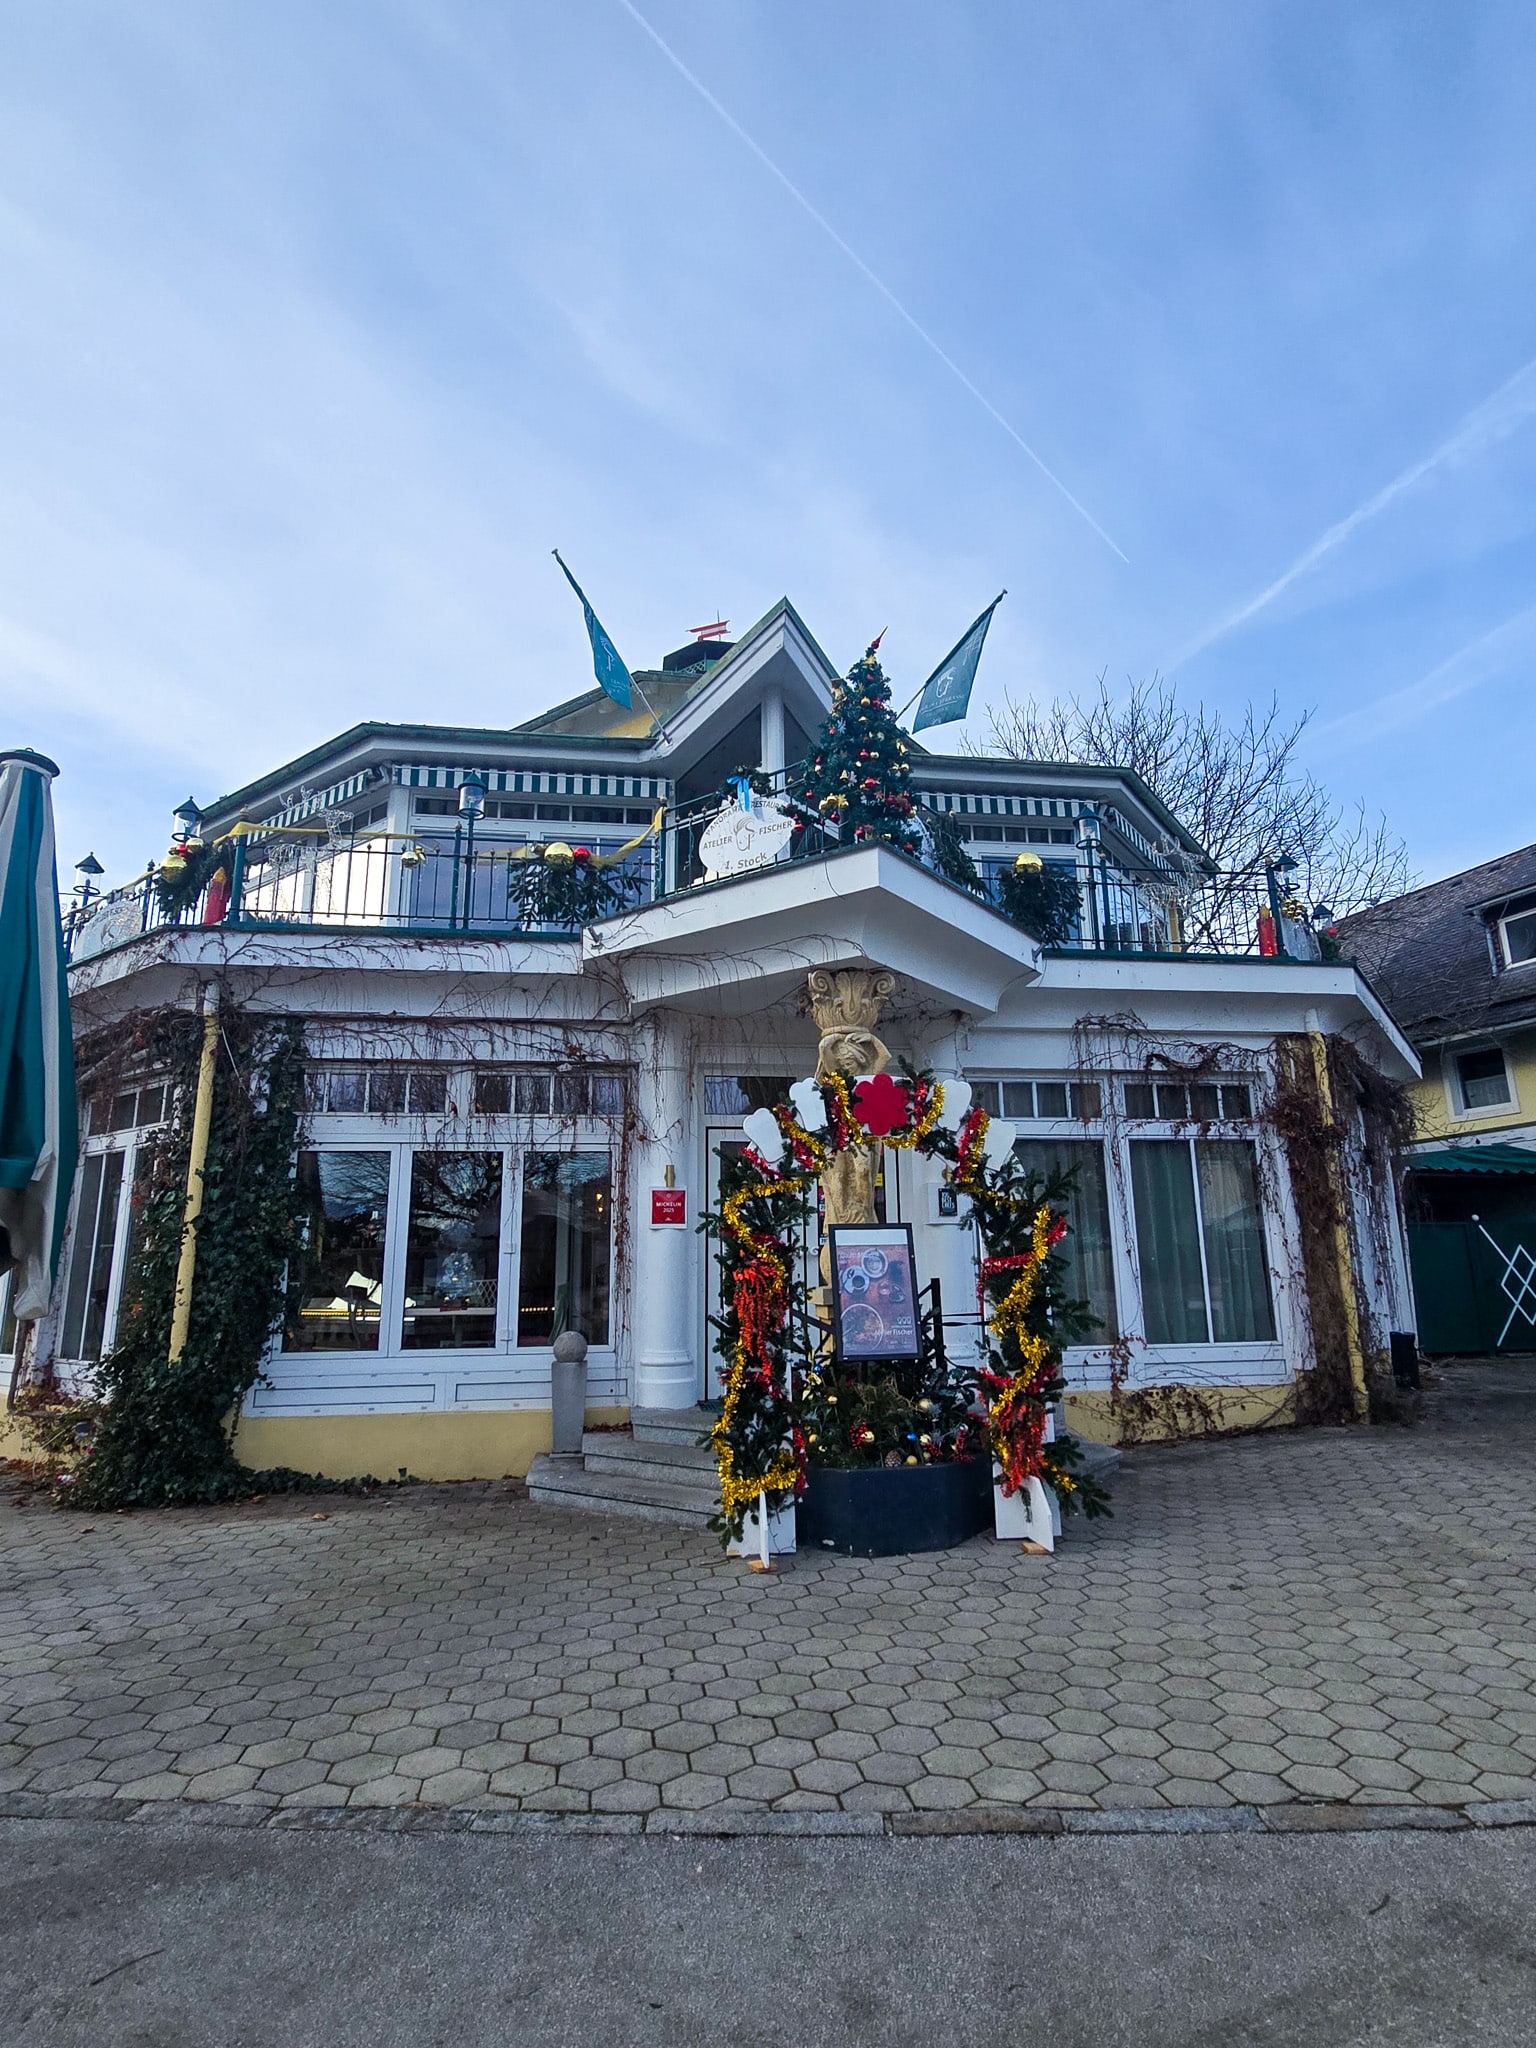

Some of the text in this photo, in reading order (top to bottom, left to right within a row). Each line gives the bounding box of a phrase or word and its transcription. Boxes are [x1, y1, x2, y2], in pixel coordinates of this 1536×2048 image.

[750, 800, 780, 809] RESTAUR
[703, 820, 792, 850] ATELIER FISCHER
[724, 852, 767, 870] 1. Stock
